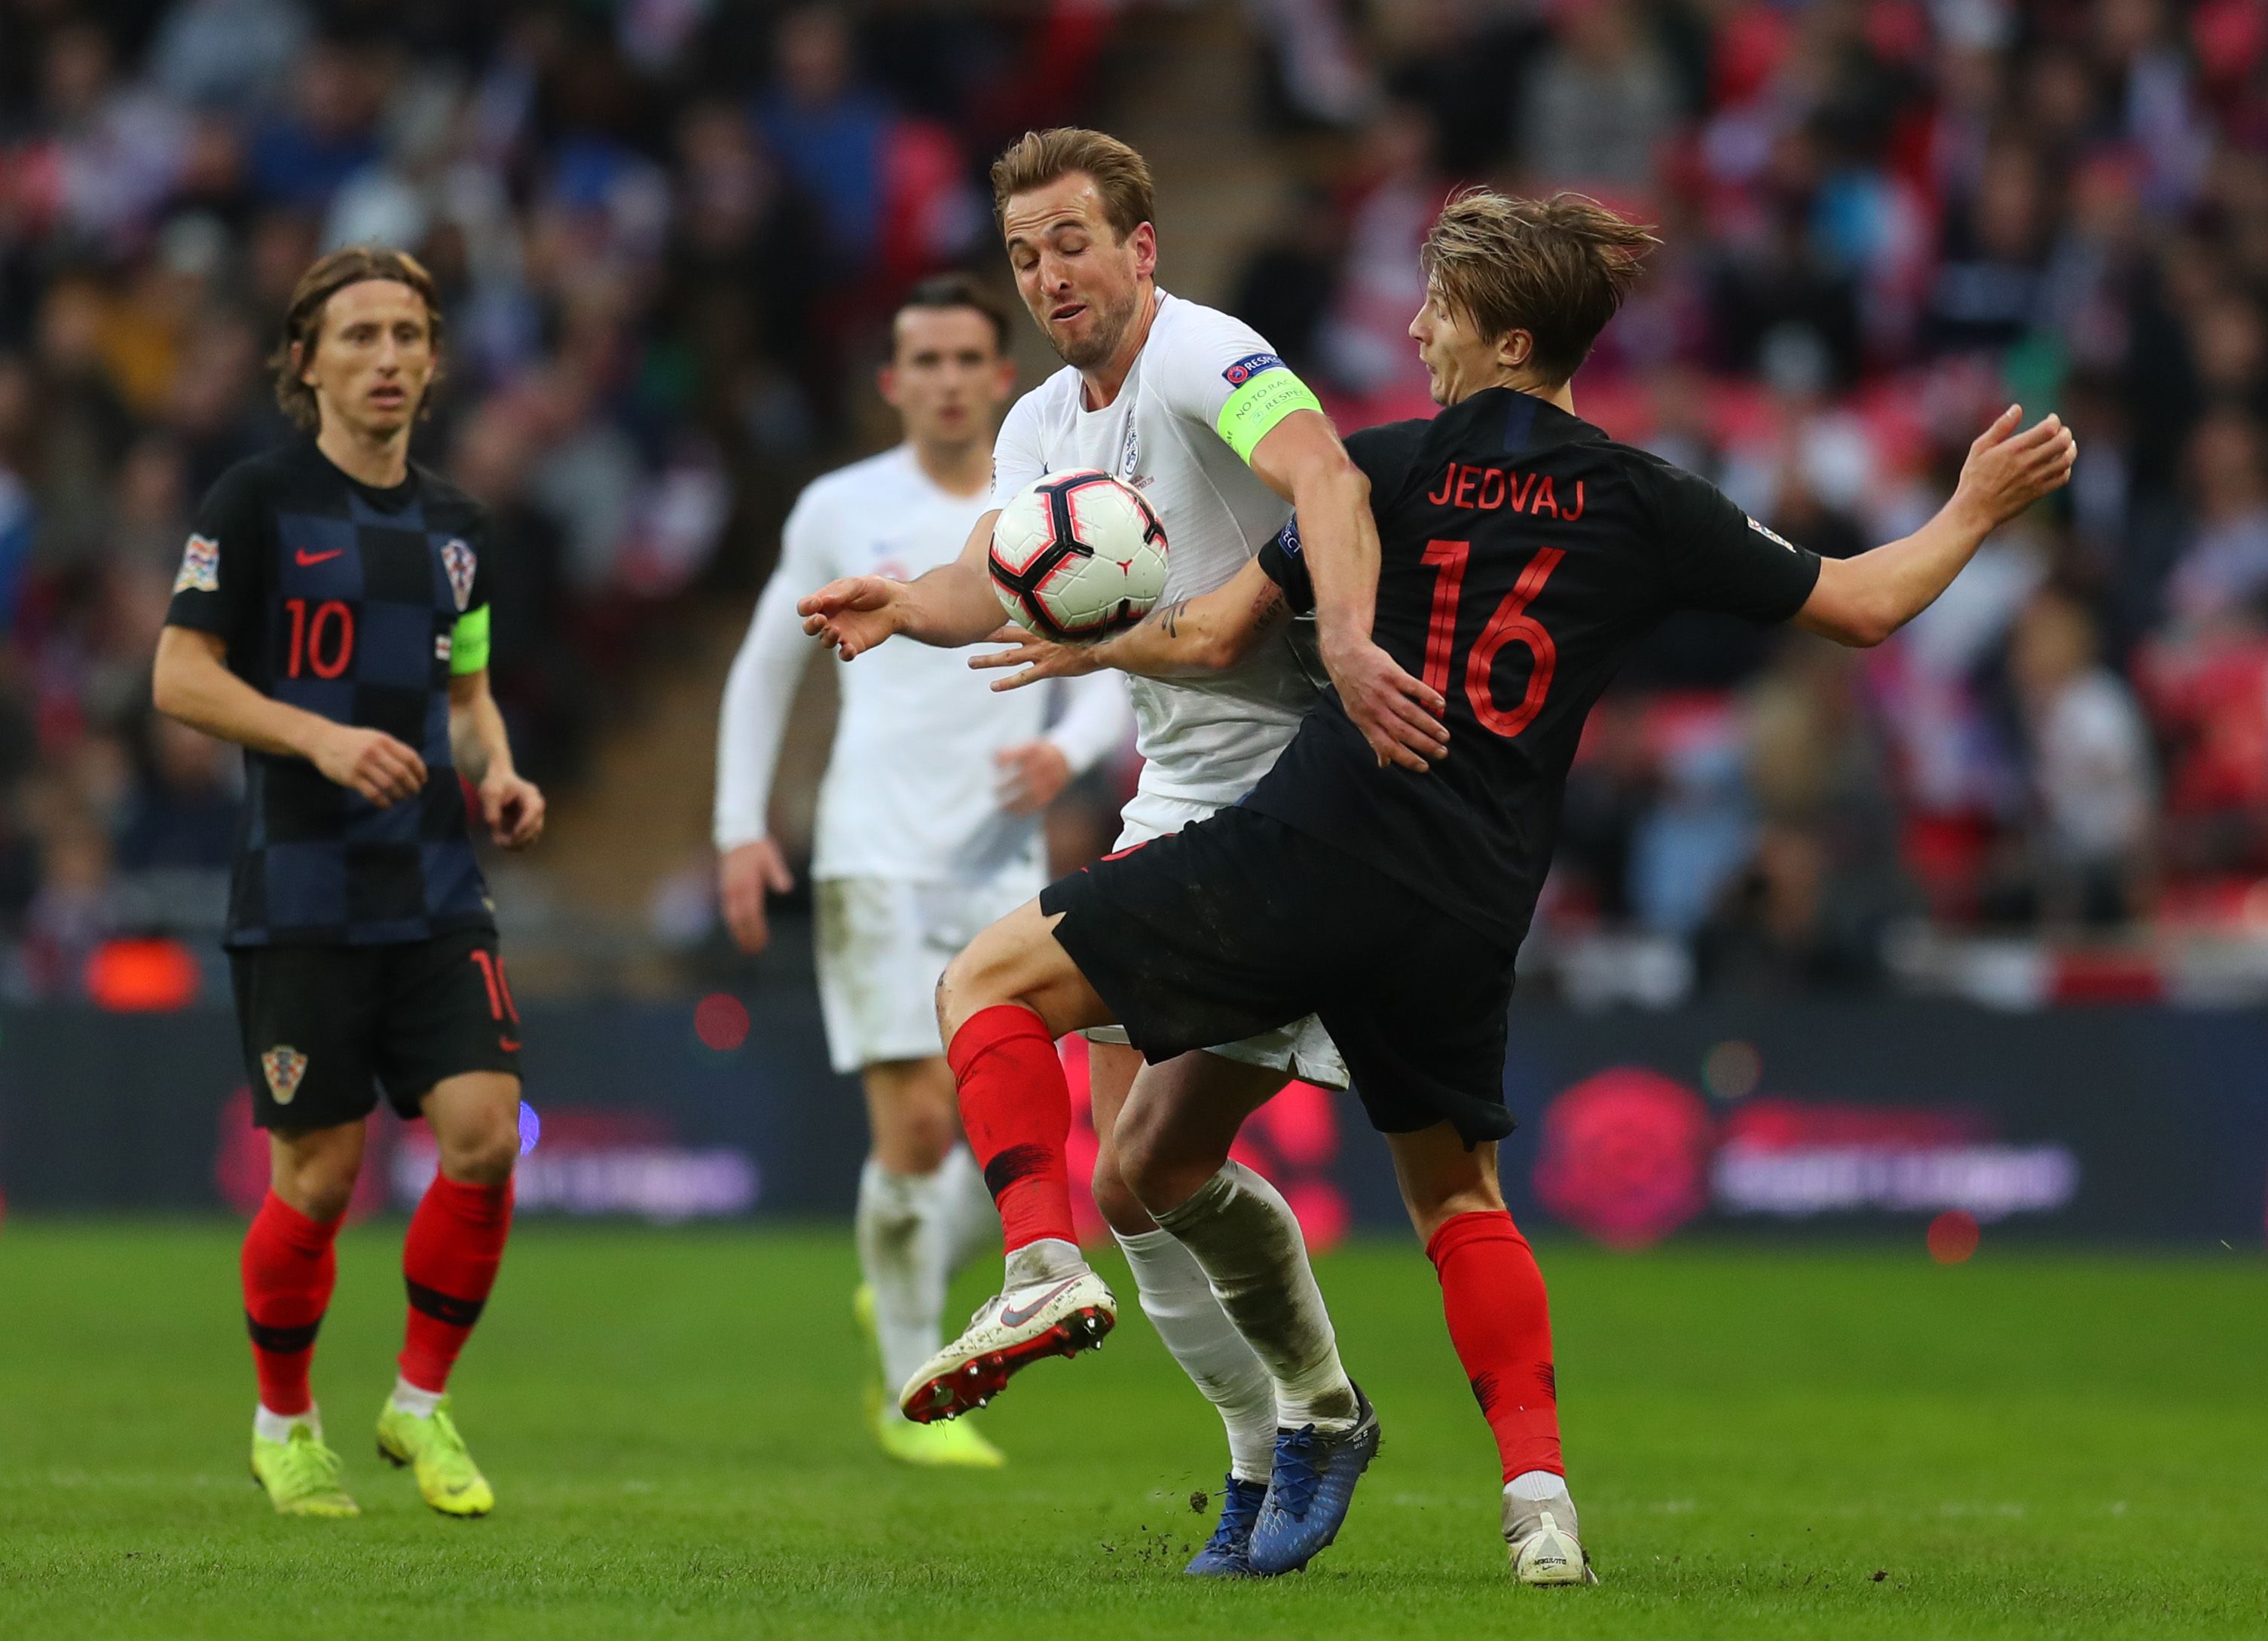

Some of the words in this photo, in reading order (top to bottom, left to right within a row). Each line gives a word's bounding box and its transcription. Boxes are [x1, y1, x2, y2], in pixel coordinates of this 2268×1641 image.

[1236, 402, 1252, 420] NO
[1251, 389, 1267, 402] TO
[1427, 462, 1585, 521] JEDVAJ
[286, 598, 355, 679] 10
[1420, 539, 1567, 738] 16
